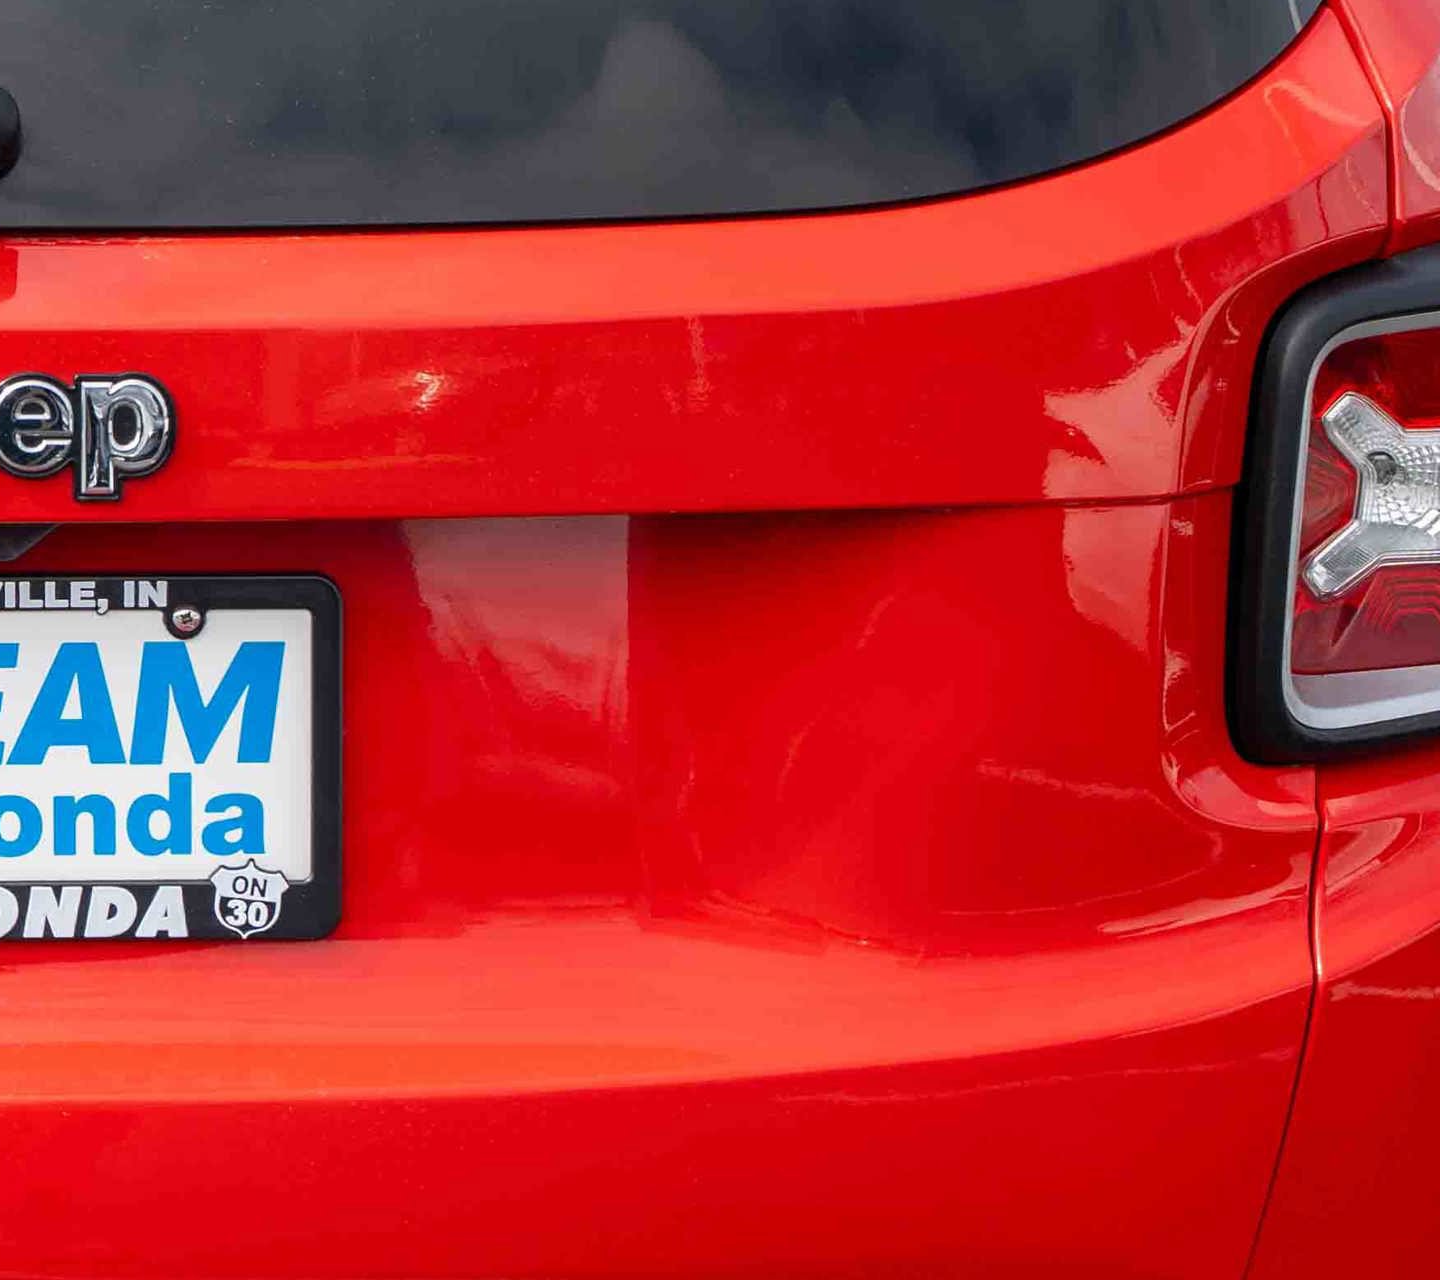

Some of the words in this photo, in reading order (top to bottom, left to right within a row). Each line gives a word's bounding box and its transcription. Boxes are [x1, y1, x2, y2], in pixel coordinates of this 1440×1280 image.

[123, 580, 169, 608] IN
[232, 875, 268, 898] ON
[224, 899, 269, 928] 30
